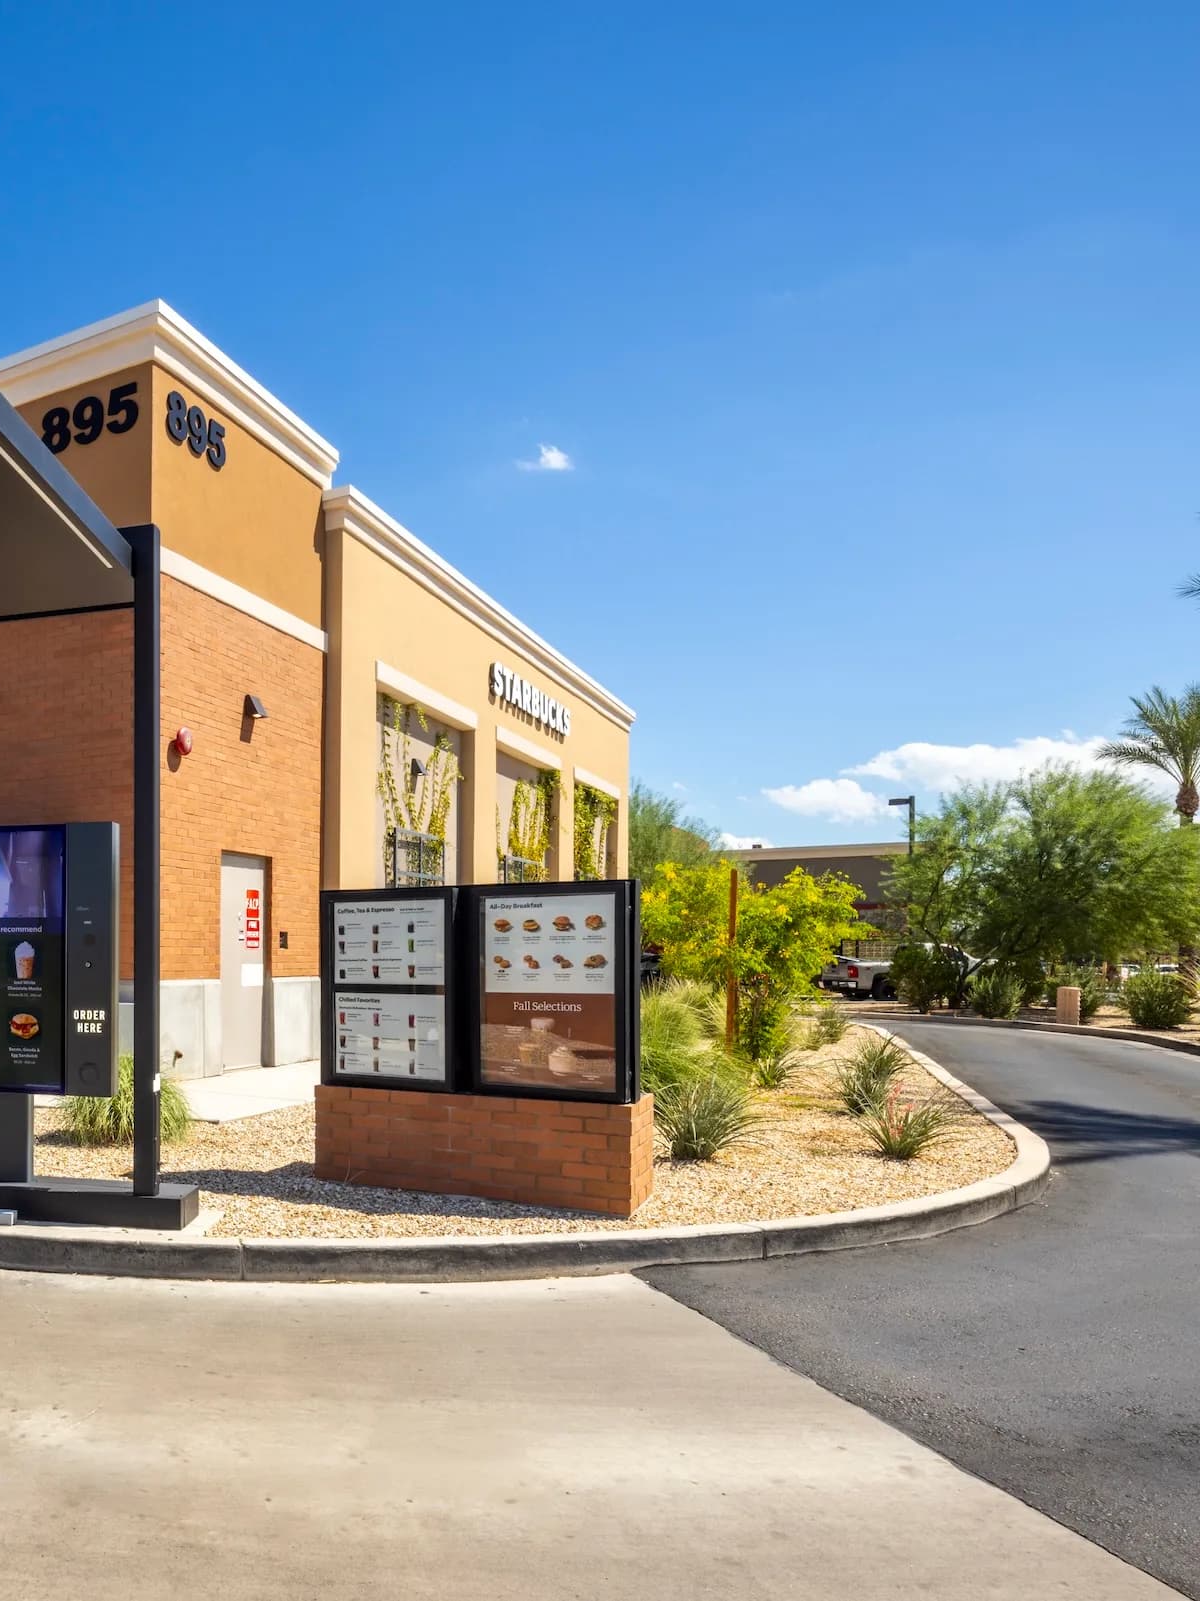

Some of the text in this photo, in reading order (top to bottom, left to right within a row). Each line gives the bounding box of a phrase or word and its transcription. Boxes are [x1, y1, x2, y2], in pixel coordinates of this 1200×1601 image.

[42, 382, 139, 454] 895
[166, 391, 226, 470] 895
[489, 661, 571, 737] STARBUCKS
[0, 925, 43, 933] recommend
[513, 1001, 582, 1012] Fall Selections
[73, 1009, 106, 1021] ORDER
[77, 1022, 103, 1033] HERE
